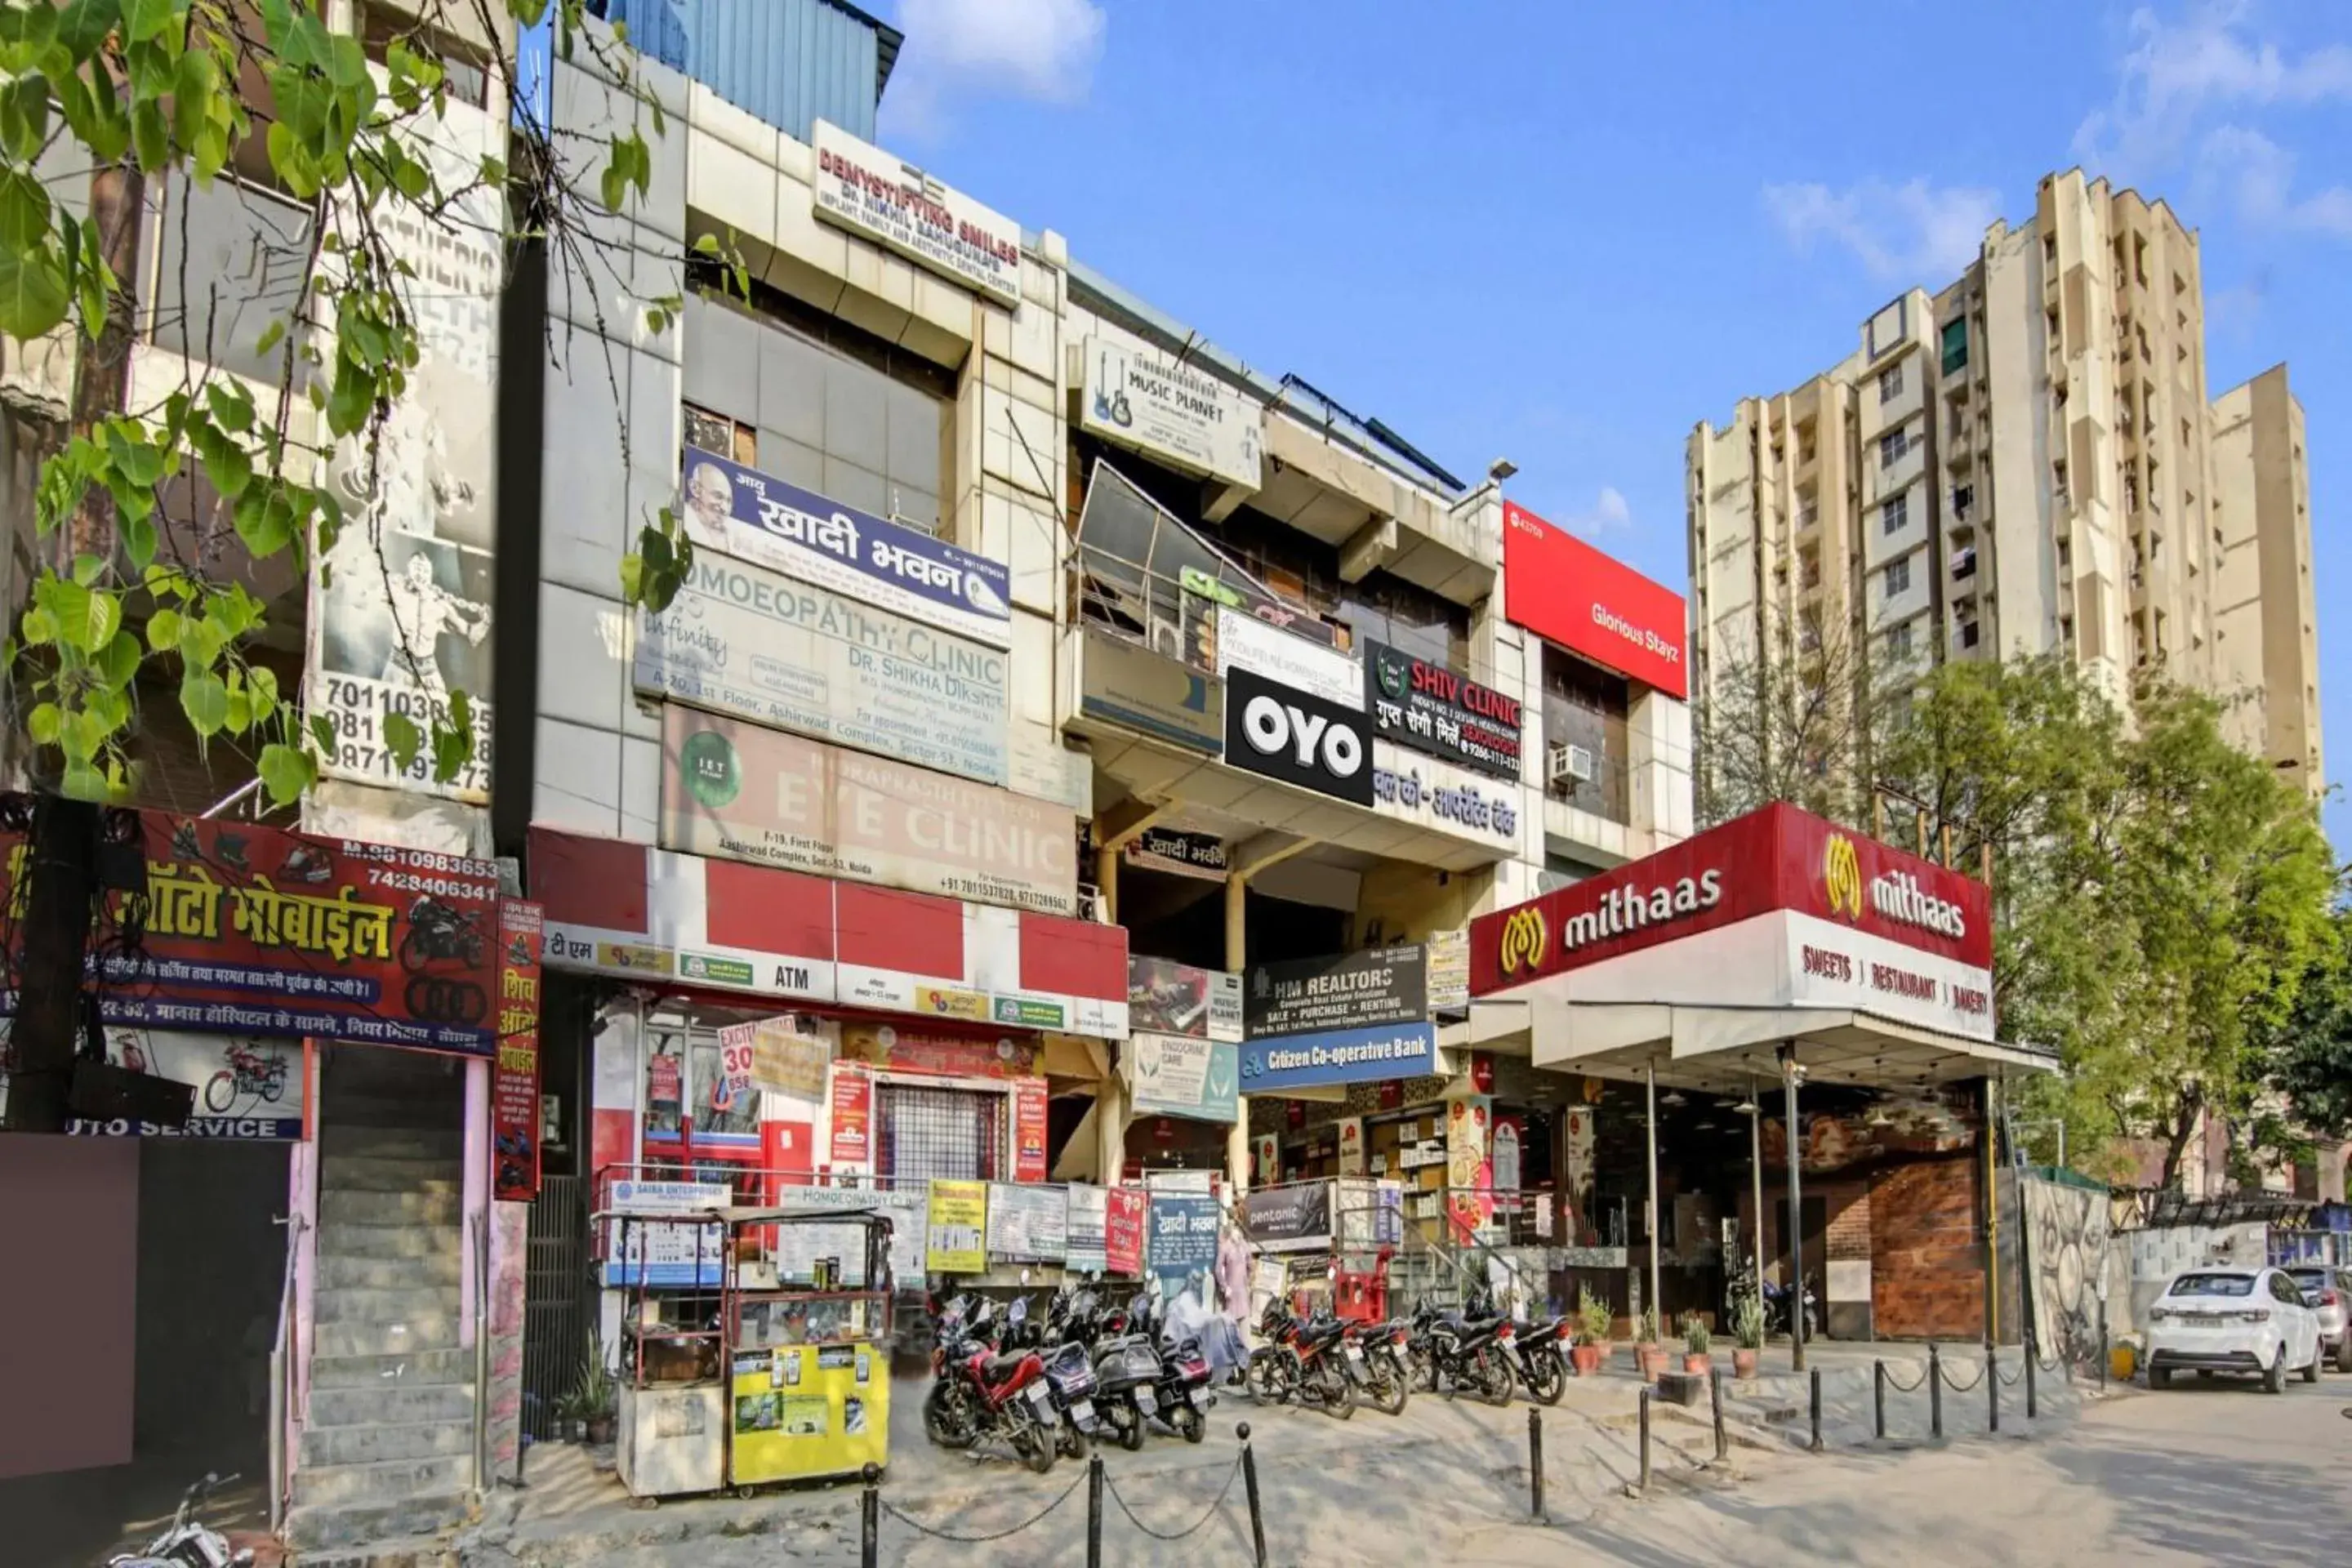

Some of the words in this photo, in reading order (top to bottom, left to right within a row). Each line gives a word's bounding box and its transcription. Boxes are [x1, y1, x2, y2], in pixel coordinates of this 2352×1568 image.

[959, 220, 1018, 267] SMILES
[1129, 370, 1172, 402] MUSIC
[1176, 390, 1224, 424] PLANET
[735, 472, 766, 497] आयु
[756, 497, 860, 560] खादी
[871, 539, 962, 597] भवन
[1592, 602, 1645, 647] Glorious
[1645, 630, 1679, 663] Stayz
[849, 647, 878, 673] DR.
[882, 657, 941, 693] SHIKHA
[1411, 661, 1459, 702] SHIV
[1463, 681, 1521, 729] CLINIC
[724, 690, 762, 714] Floor,
[769, 703, 831, 731] Ashirwad
[836, 724, 894, 750] Complex,
[1377, 699, 1403, 728] गुप्त
[1405, 705, 1432, 737] रोगी
[1241, 695, 1363, 778] OYO
[905, 804, 1067, 876] CLINIC
[1150, 836, 1187, 859] खादी
[368, 868, 496, 902] 7428406341
[849, 862, 872, 875] Noida
[940, 876, 959, 891] +91
[1564, 867, 1723, 950] mithaas
[1869, 868, 1966, 938] mithaas
[551, 931, 565, 956] टी
[568, 941, 592, 960] एम
[503, 968, 536, 1002] शिव
[774, 964, 809, 991] ATM
[1274, 980, 1302, 1000] HM
[1307, 967, 1393, 996] REALTORS
[1802, 944, 1852, 982] SWEETS
[1871, 962, 1936, 1003] RESTAURANT
[347, 1016, 382, 1038] नियर
[1267, 1010, 1289, 1023] SALE
[1299, 1003, 1348, 1019] PURCHASE
[1361, 996, 1401, 1013] RENTING
[1268, 1049, 1310, 1070] Citizen
[1312, 1040, 1392, 1068] Co-operative
[1393, 1035, 1426, 1058] Bank
[1250, 1206, 1298, 1227] pentonic
